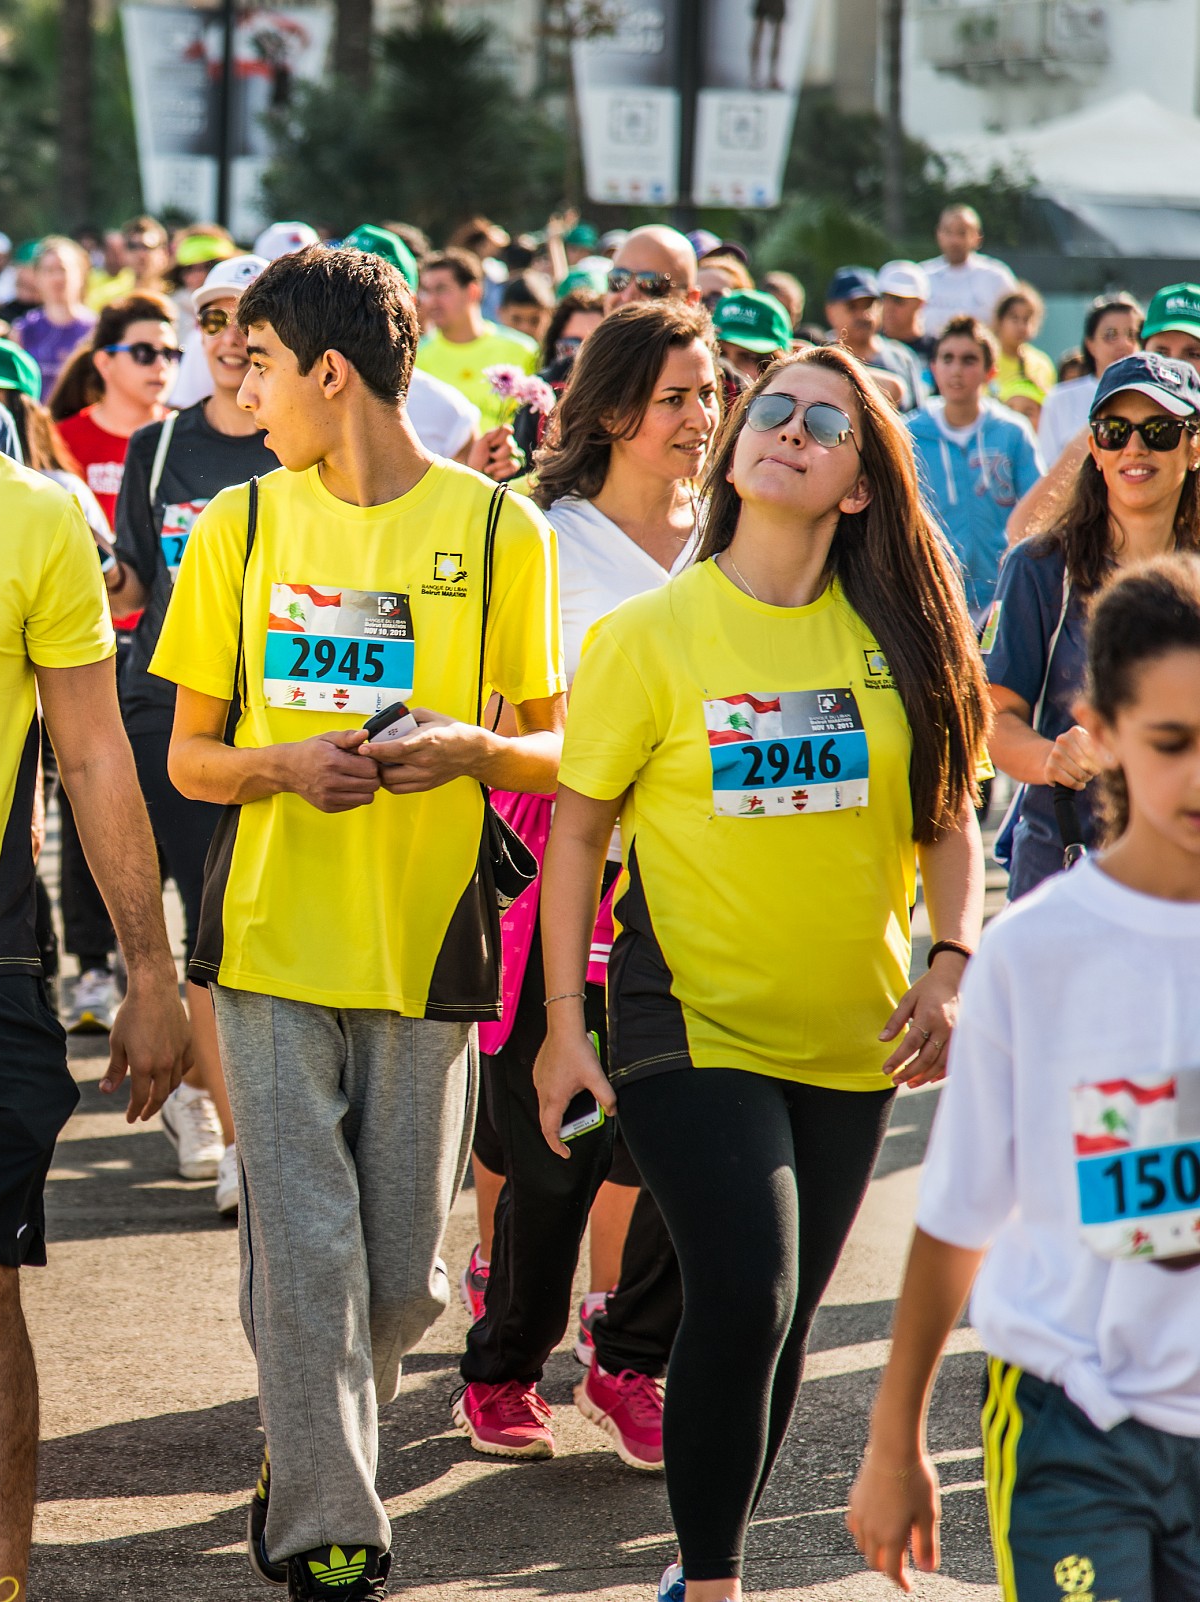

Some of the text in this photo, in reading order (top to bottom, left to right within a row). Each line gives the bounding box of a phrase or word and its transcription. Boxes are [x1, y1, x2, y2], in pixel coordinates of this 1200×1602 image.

[363, 627, 378, 635] NOV
[390, 629, 407, 637] 2013
[288, 637, 385, 682] 2945
[837, 722, 854, 730] 2013
[741, 738, 841, 786] 2946
